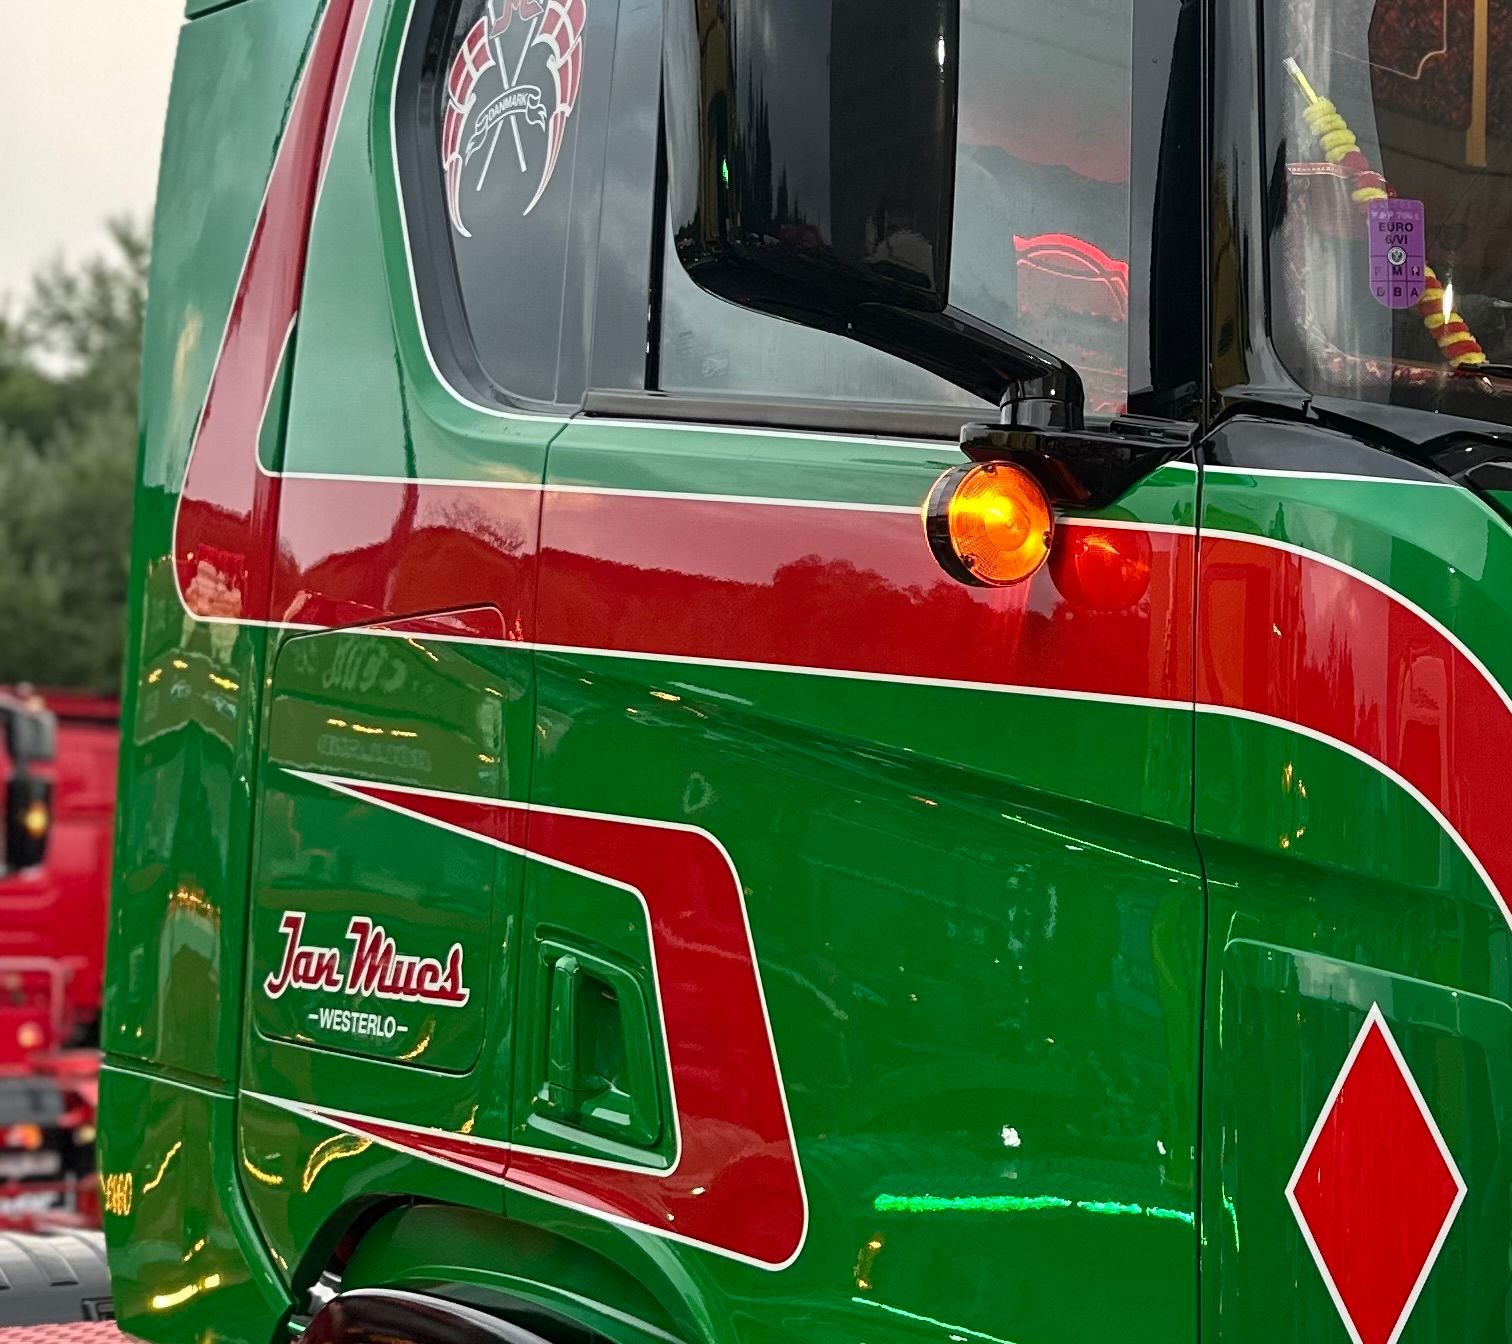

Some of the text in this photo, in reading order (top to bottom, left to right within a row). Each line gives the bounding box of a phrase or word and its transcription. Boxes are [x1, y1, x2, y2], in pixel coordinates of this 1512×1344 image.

[488, 92, 528, 123] DANMARK
[1378, 221, 1414, 233] EURO
[1385, 234, 1408, 245] 6/VI
[1392, 266, 1402, 277] M
[1393, 286, 1402, 297] B
[1410, 287, 1419, 297] A
[264, 910, 344, 1000] Jan
